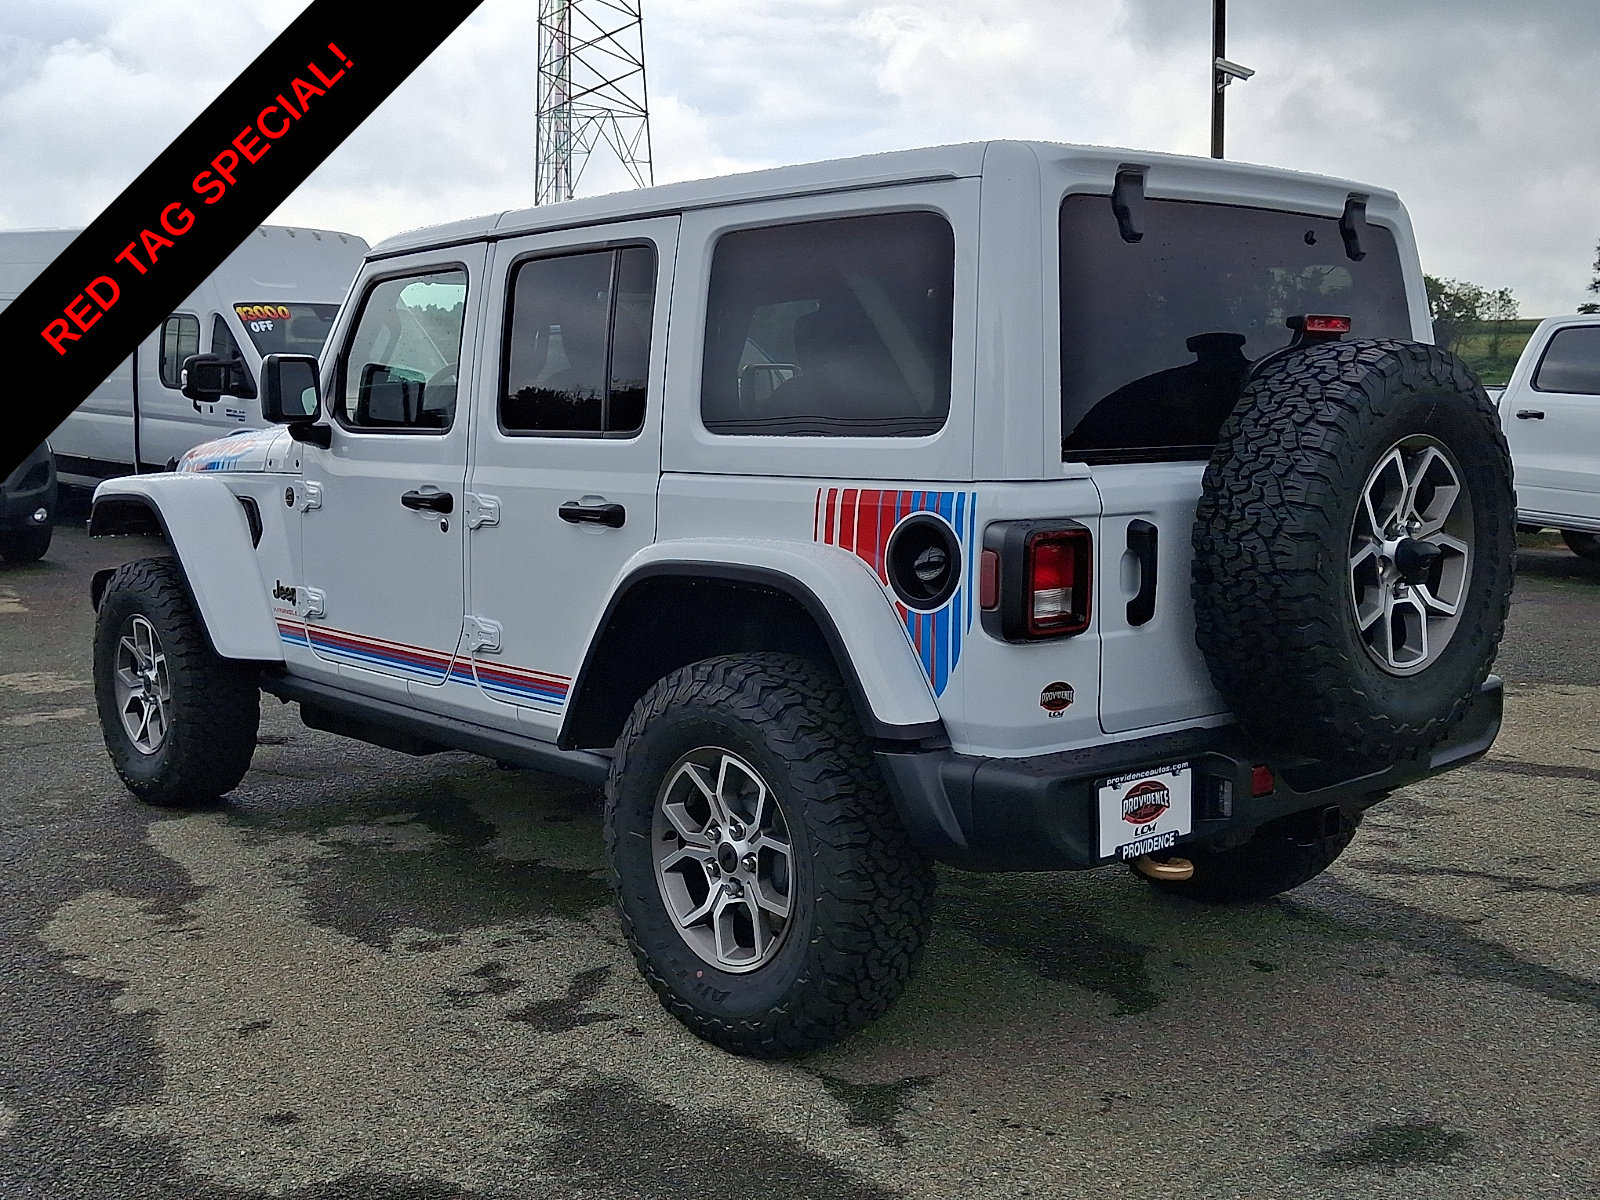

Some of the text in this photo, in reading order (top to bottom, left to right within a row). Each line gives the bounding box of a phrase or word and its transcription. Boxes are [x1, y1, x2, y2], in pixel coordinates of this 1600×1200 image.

[236, 305, 291, 321] 13000
[250, 320, 274, 333] OFF
[272, 579, 297, 607] Jeep
[1041, 690, 1074, 705] PROVIDENCE
[1106, 762, 1189, 787] providenceautos.com
[1122, 789, 1169, 818] PROVIDENCE
[1122, 832, 1175, 860] PROVIDENCE
